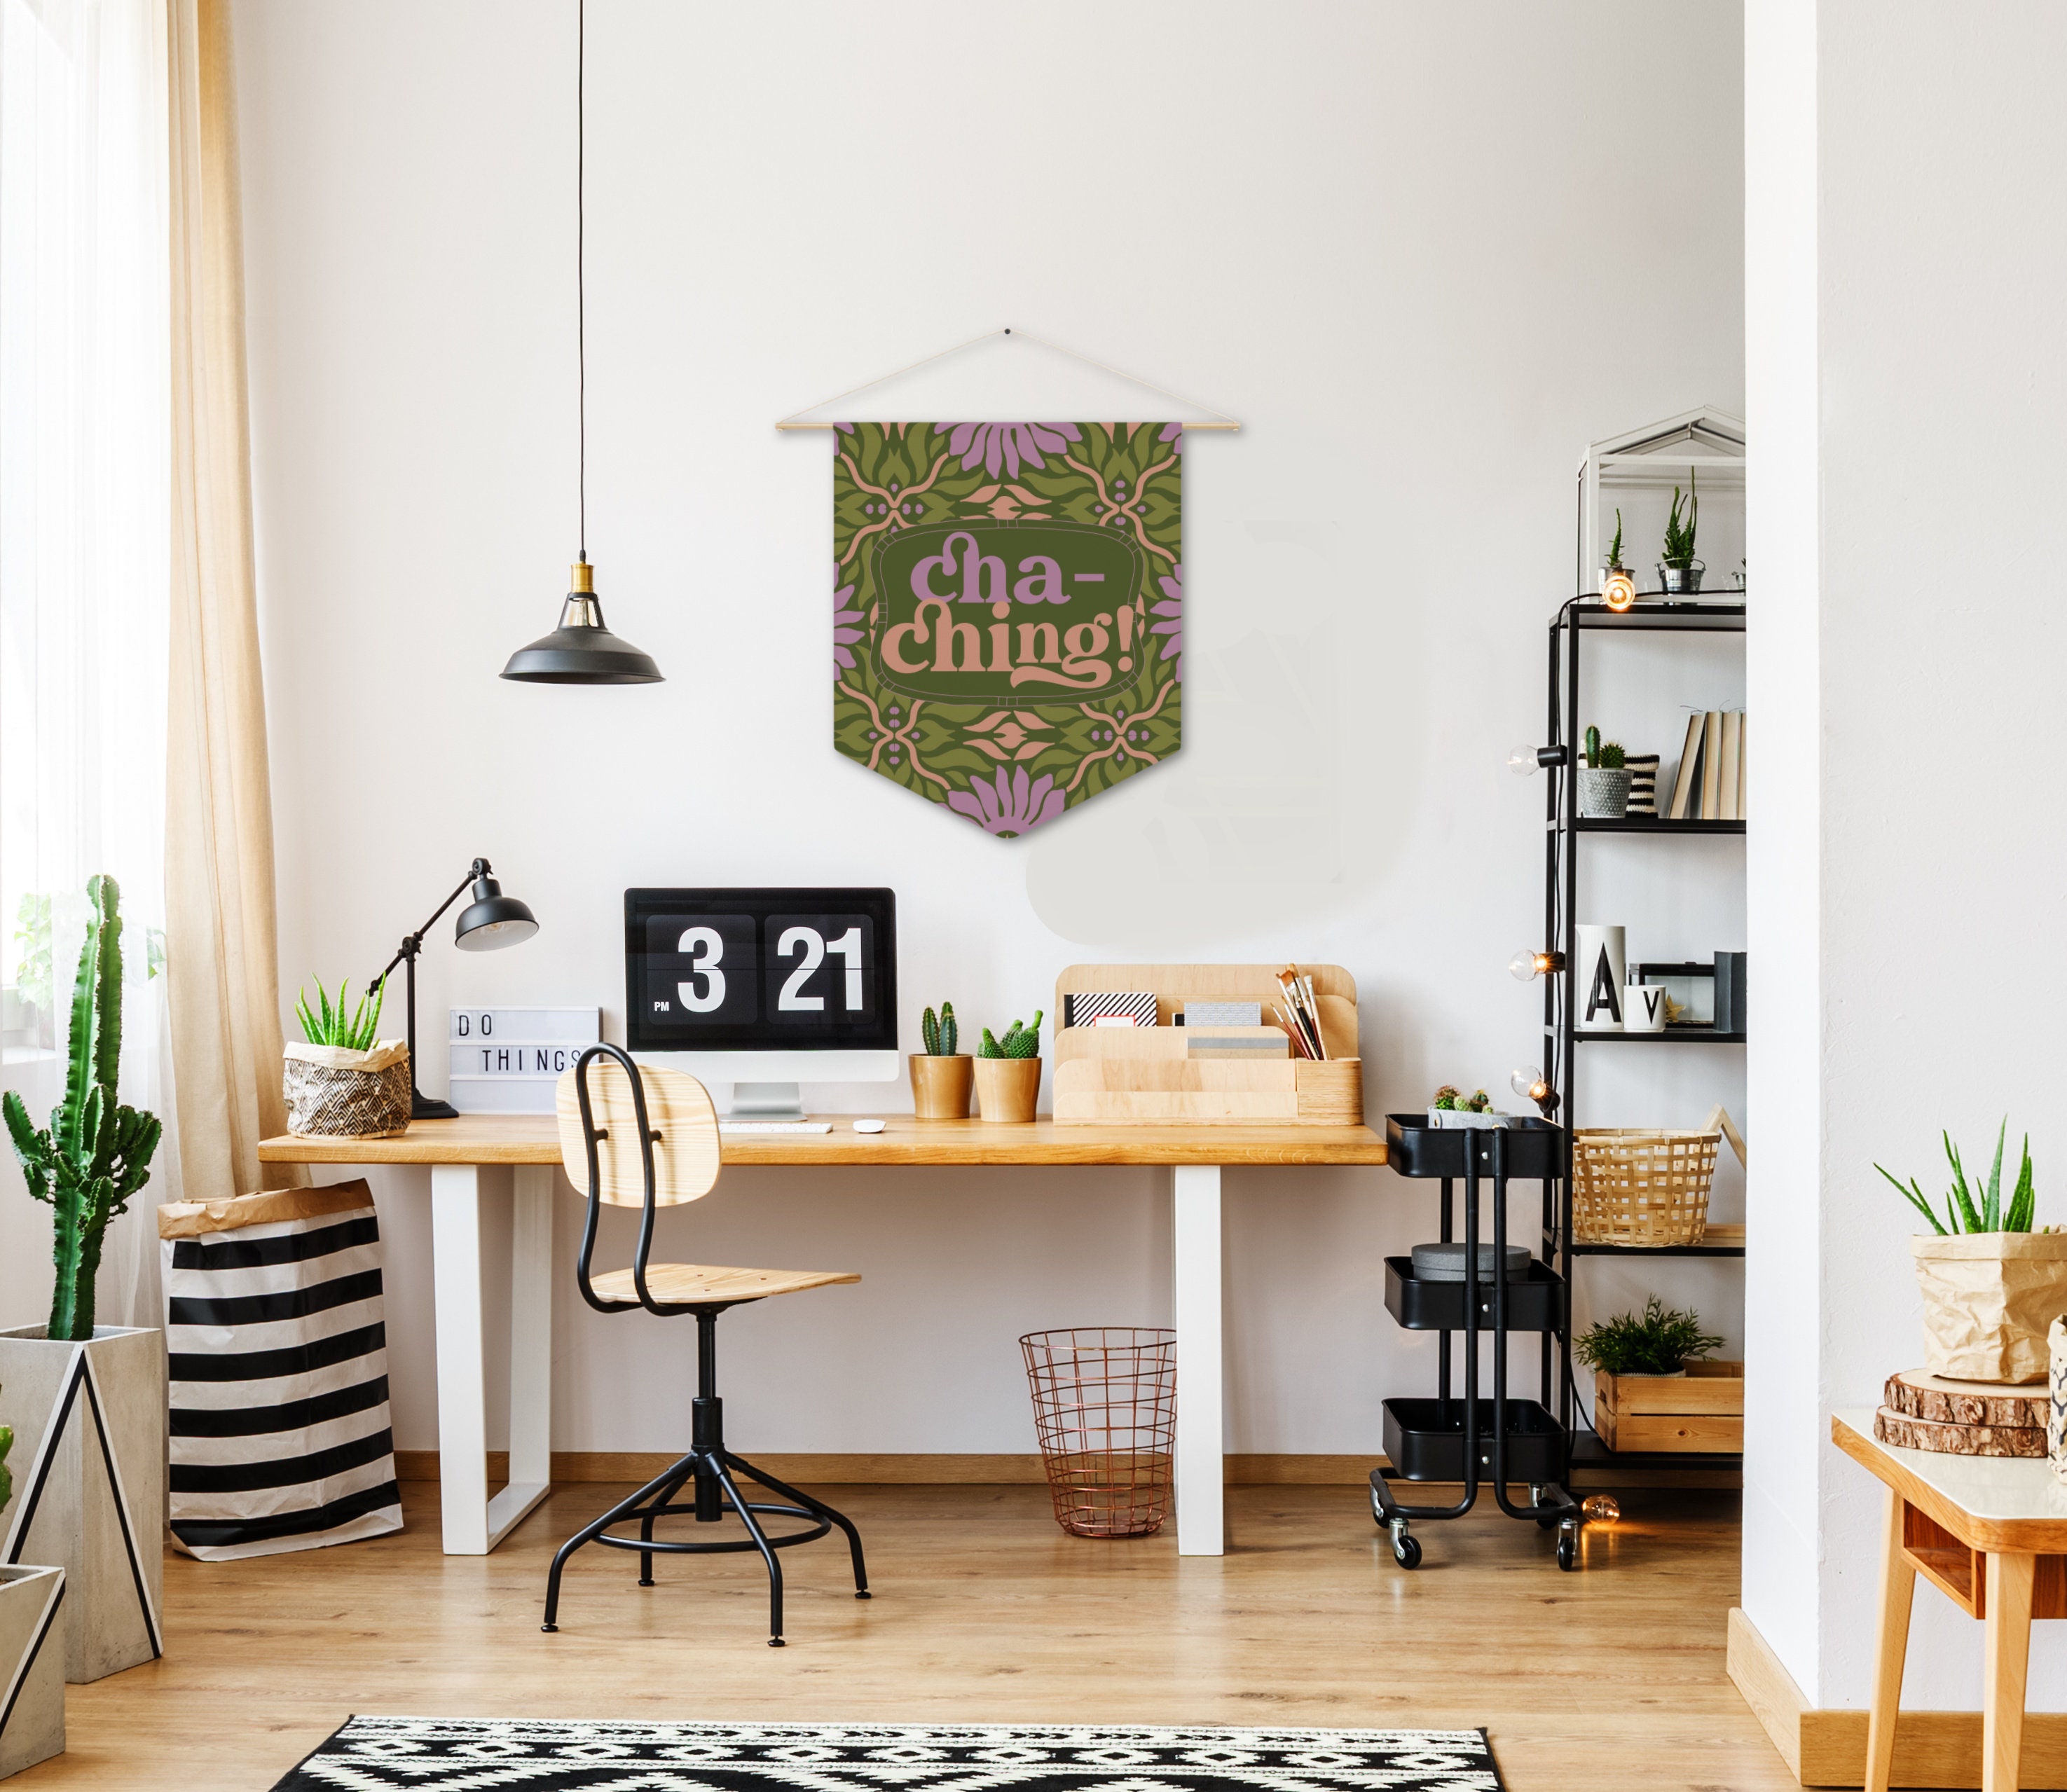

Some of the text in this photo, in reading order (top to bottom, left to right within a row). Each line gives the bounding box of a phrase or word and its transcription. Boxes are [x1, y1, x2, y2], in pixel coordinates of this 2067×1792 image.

[911, 532, 1105, 605] cha-
[881, 598, 1134, 689] ching!
[677, 926, 863, 1013] 3 21
[1585, 942, 1622, 1023] A
[458, 1014, 492, 1037] DO
[654, 1001, 670, 1012] PM
[1642, 990, 1660, 1025] V
[481, 1049, 580, 1072] THINGS
